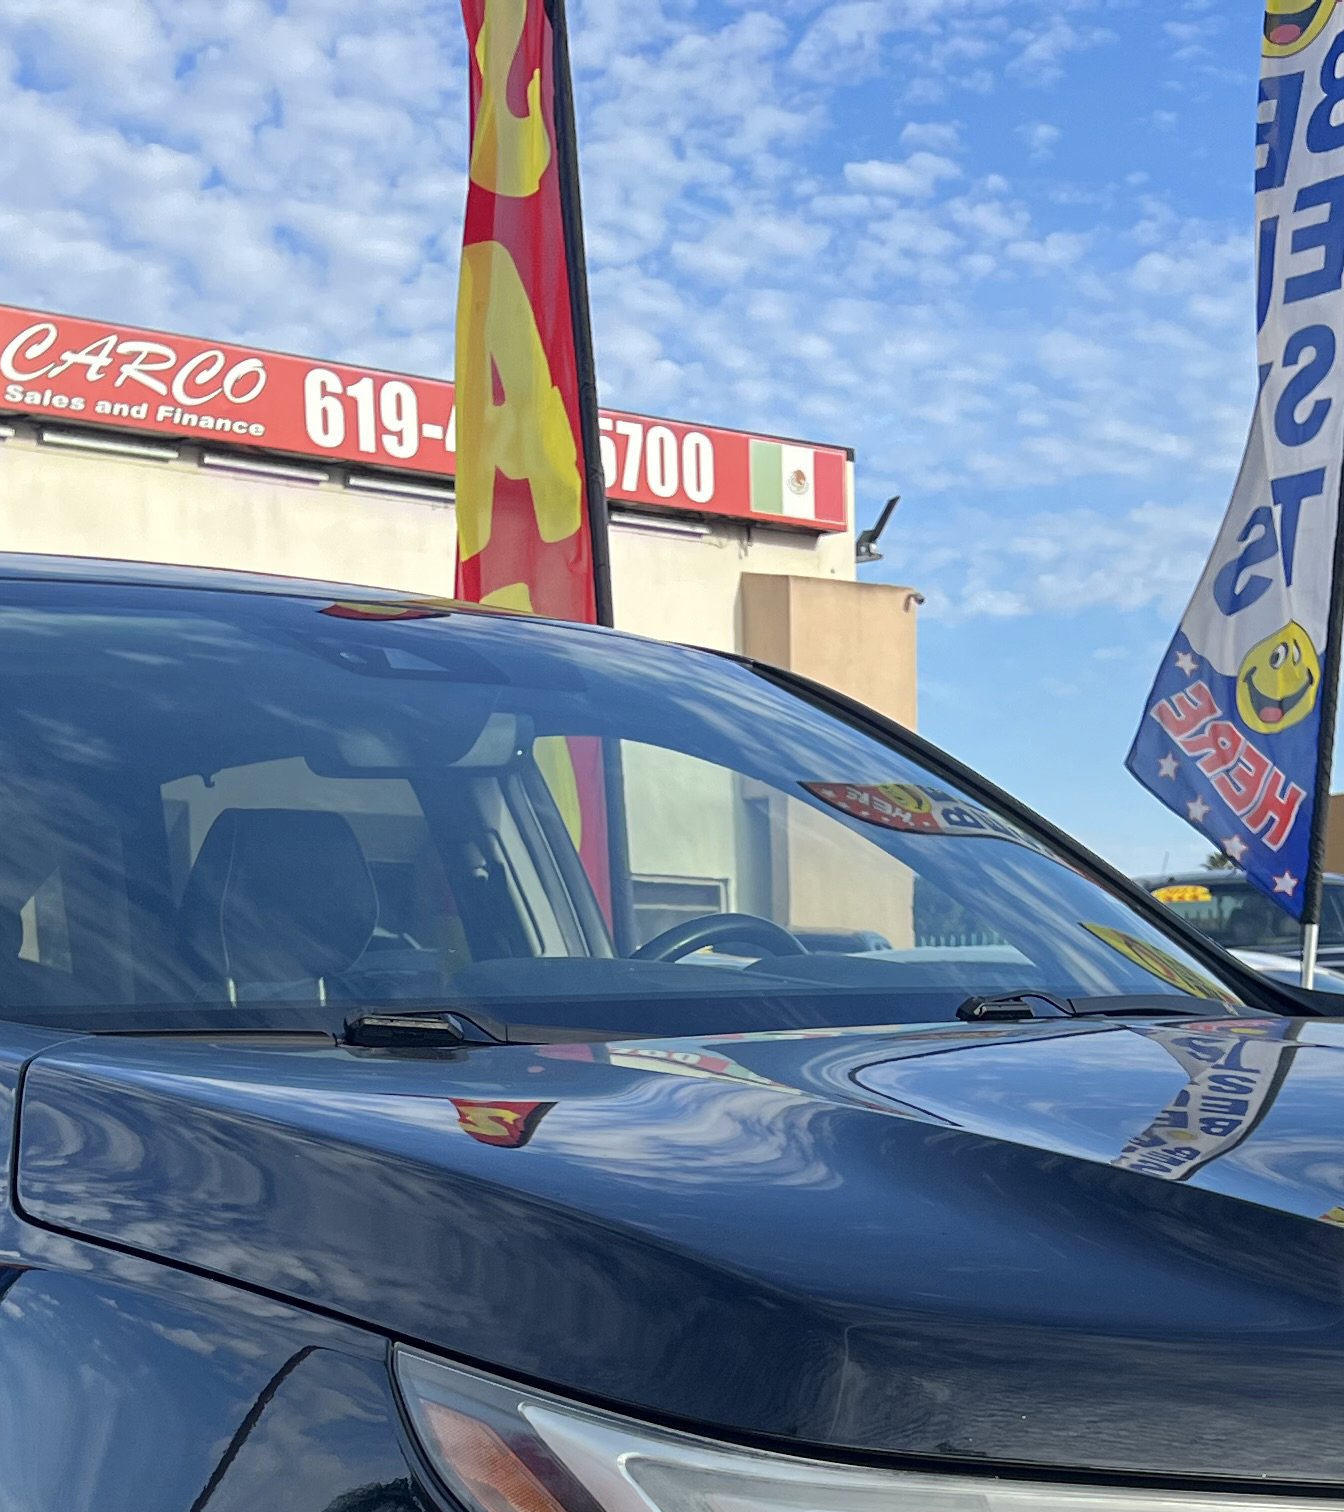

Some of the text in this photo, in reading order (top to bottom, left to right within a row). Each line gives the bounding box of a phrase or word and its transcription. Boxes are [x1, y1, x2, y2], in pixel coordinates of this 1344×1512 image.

[0, 322, 268, 407] CARCO
[4, 383, 267, 438] Sales and Finance
